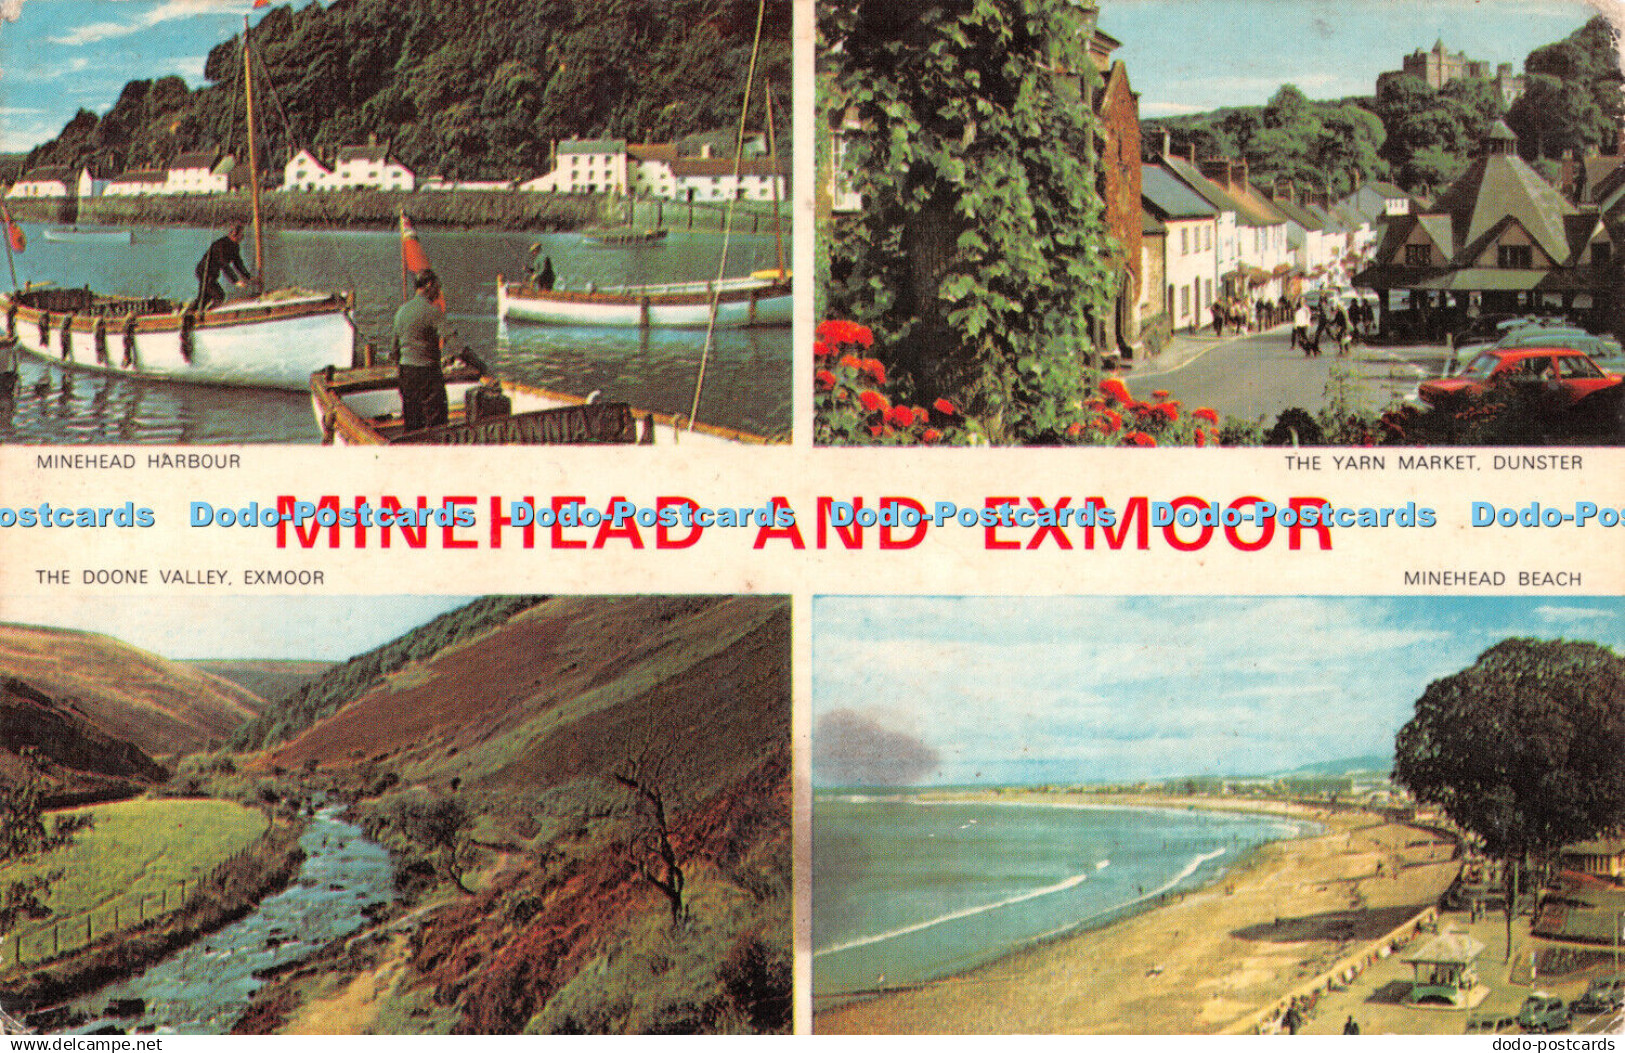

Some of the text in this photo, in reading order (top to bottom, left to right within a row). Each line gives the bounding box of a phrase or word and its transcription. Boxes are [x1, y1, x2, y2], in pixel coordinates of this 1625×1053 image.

[37, 454, 241, 469] MINEHEAD HARBOUR
[1285, 455, 1321, 471] THE
[1333, 455, 1386, 471] YARN
[1493, 455, 1584, 471] DUNSTER
[275, 495, 1333, 550] MINEHEAD AND EXMOOR
[35, 569, 325, 587] THE DOONE VALLEY, EXMOOR
[1404, 570, 1582, 586] MINEHEAD BEACH
